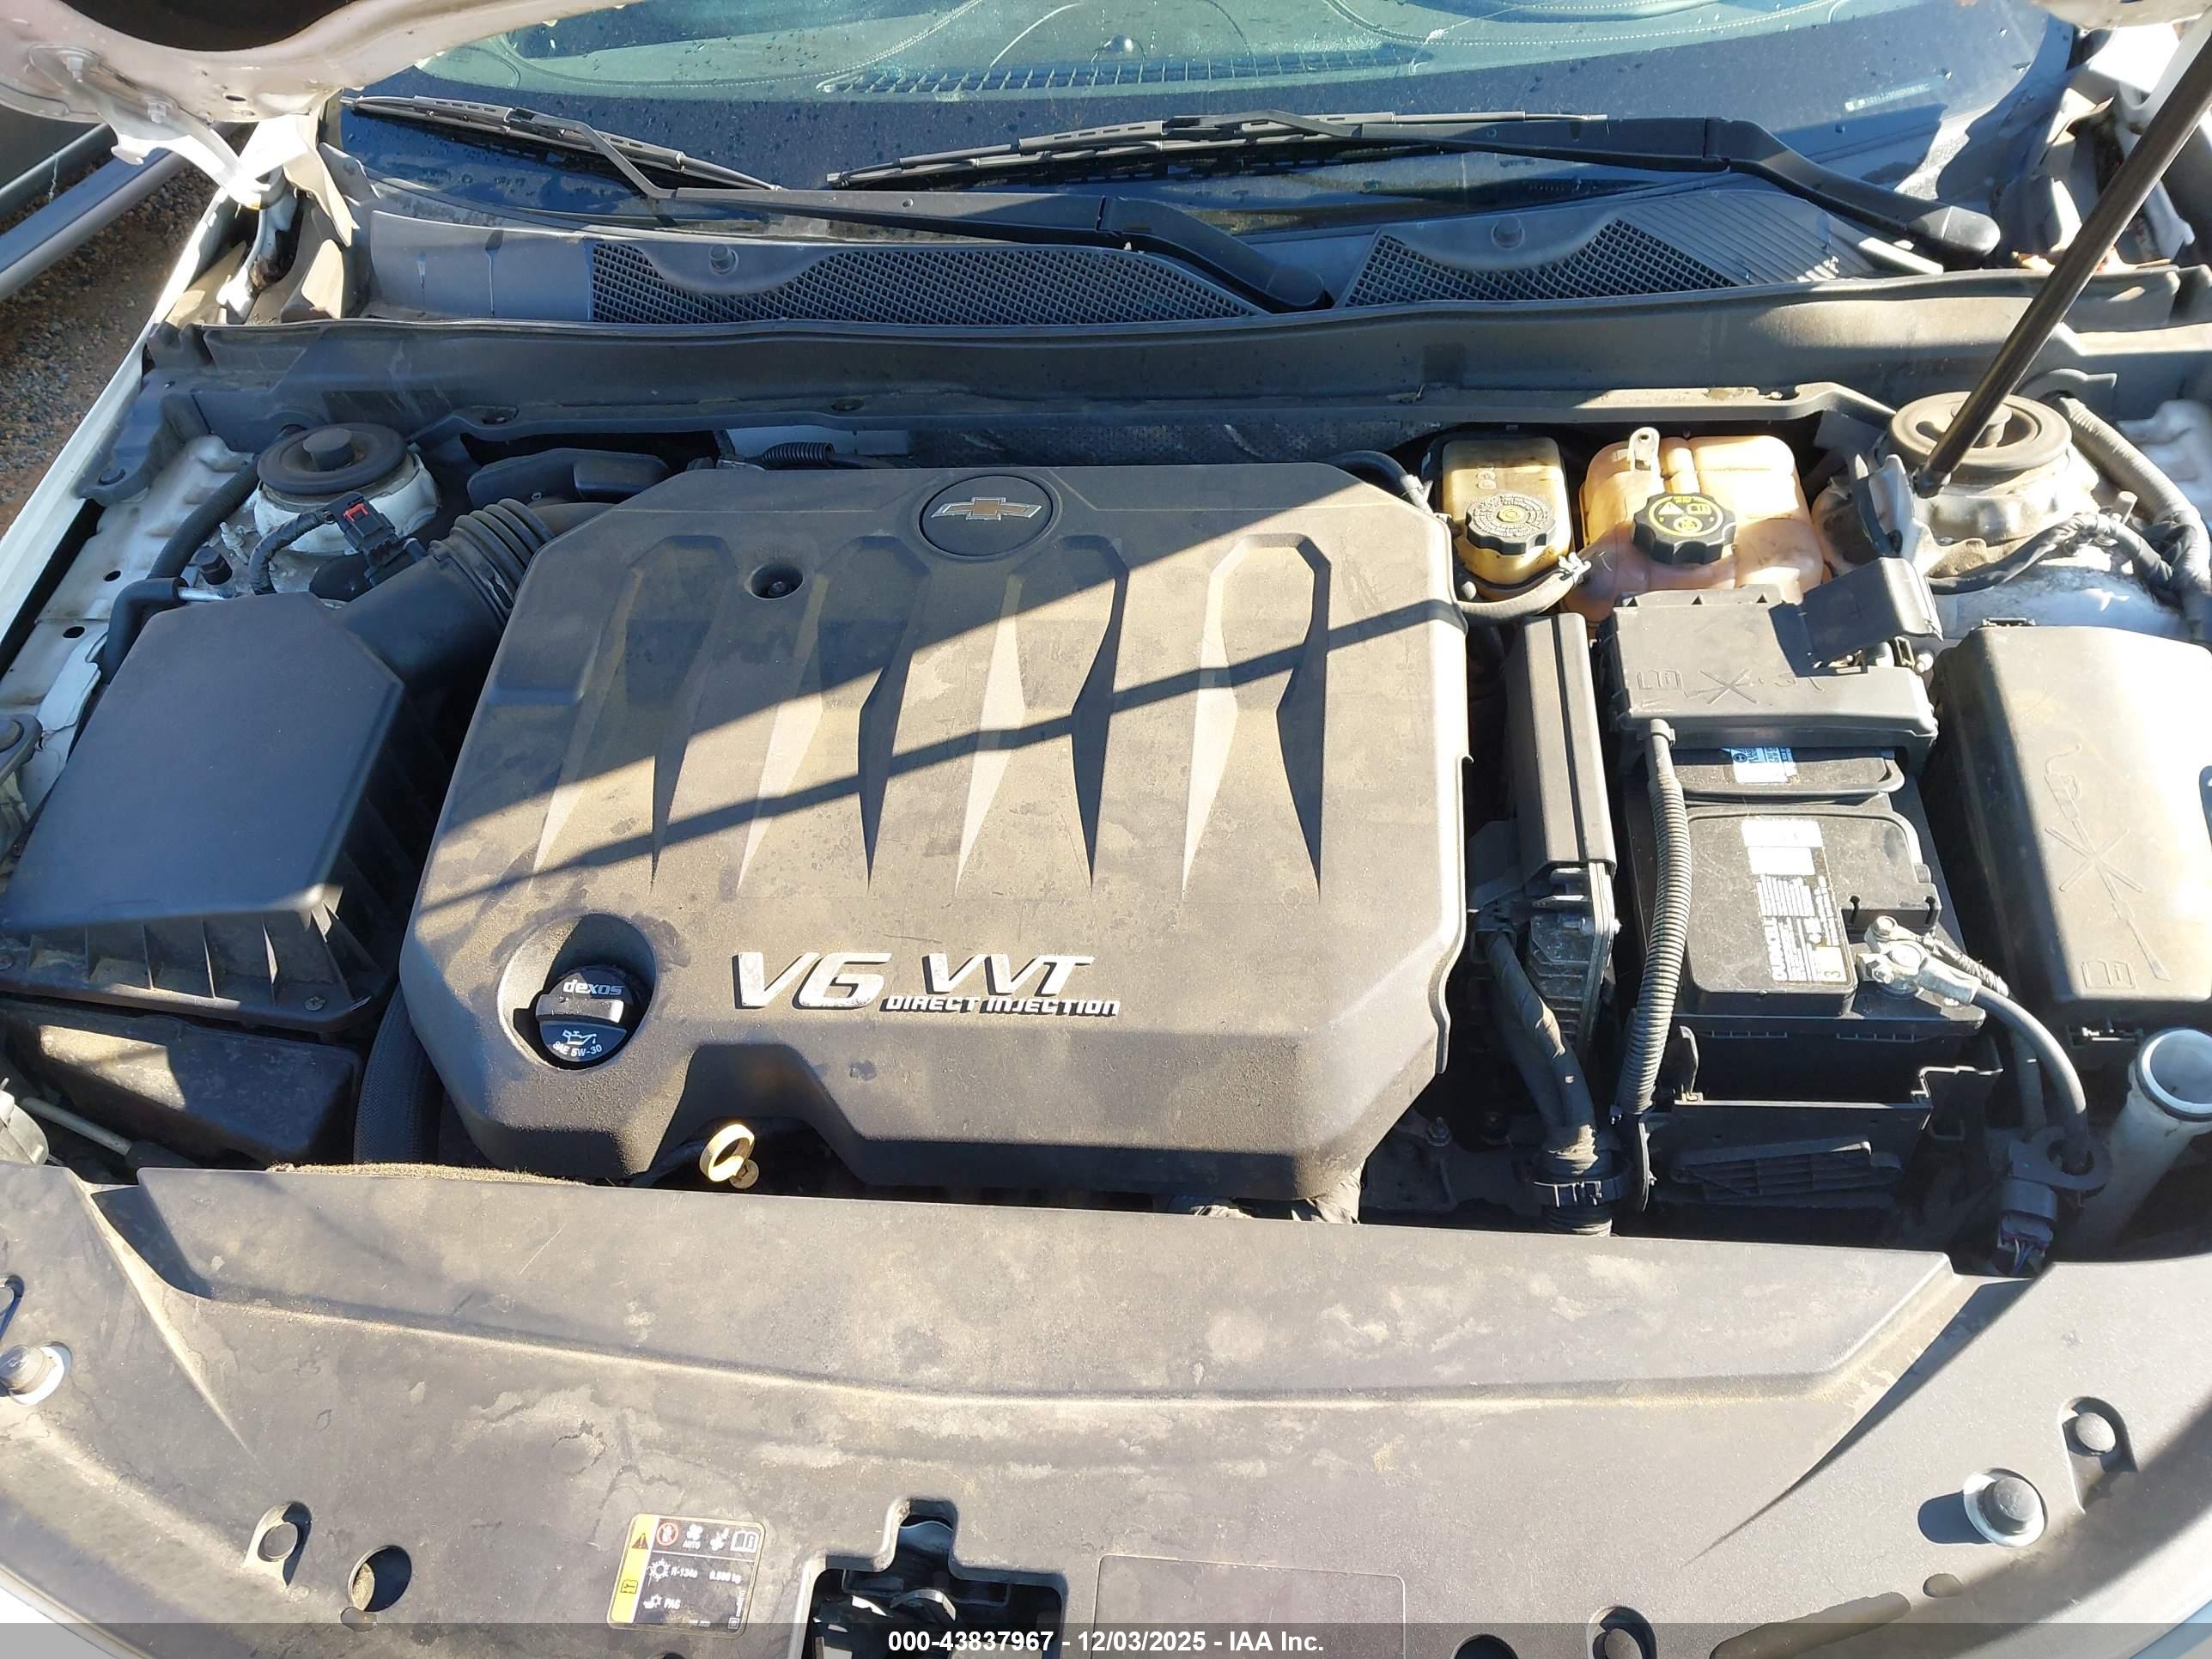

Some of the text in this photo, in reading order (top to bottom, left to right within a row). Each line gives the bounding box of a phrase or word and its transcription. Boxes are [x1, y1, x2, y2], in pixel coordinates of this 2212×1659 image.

[562, 979, 625, 995] dexos
[731, 951, 1096, 1010] V6 VVT
[879, 994, 1121, 1016] DIRECT INJECTION
[552, 1041, 603, 1057] SAE 5W-30
[683, 1540, 702, 1550] AUTO
